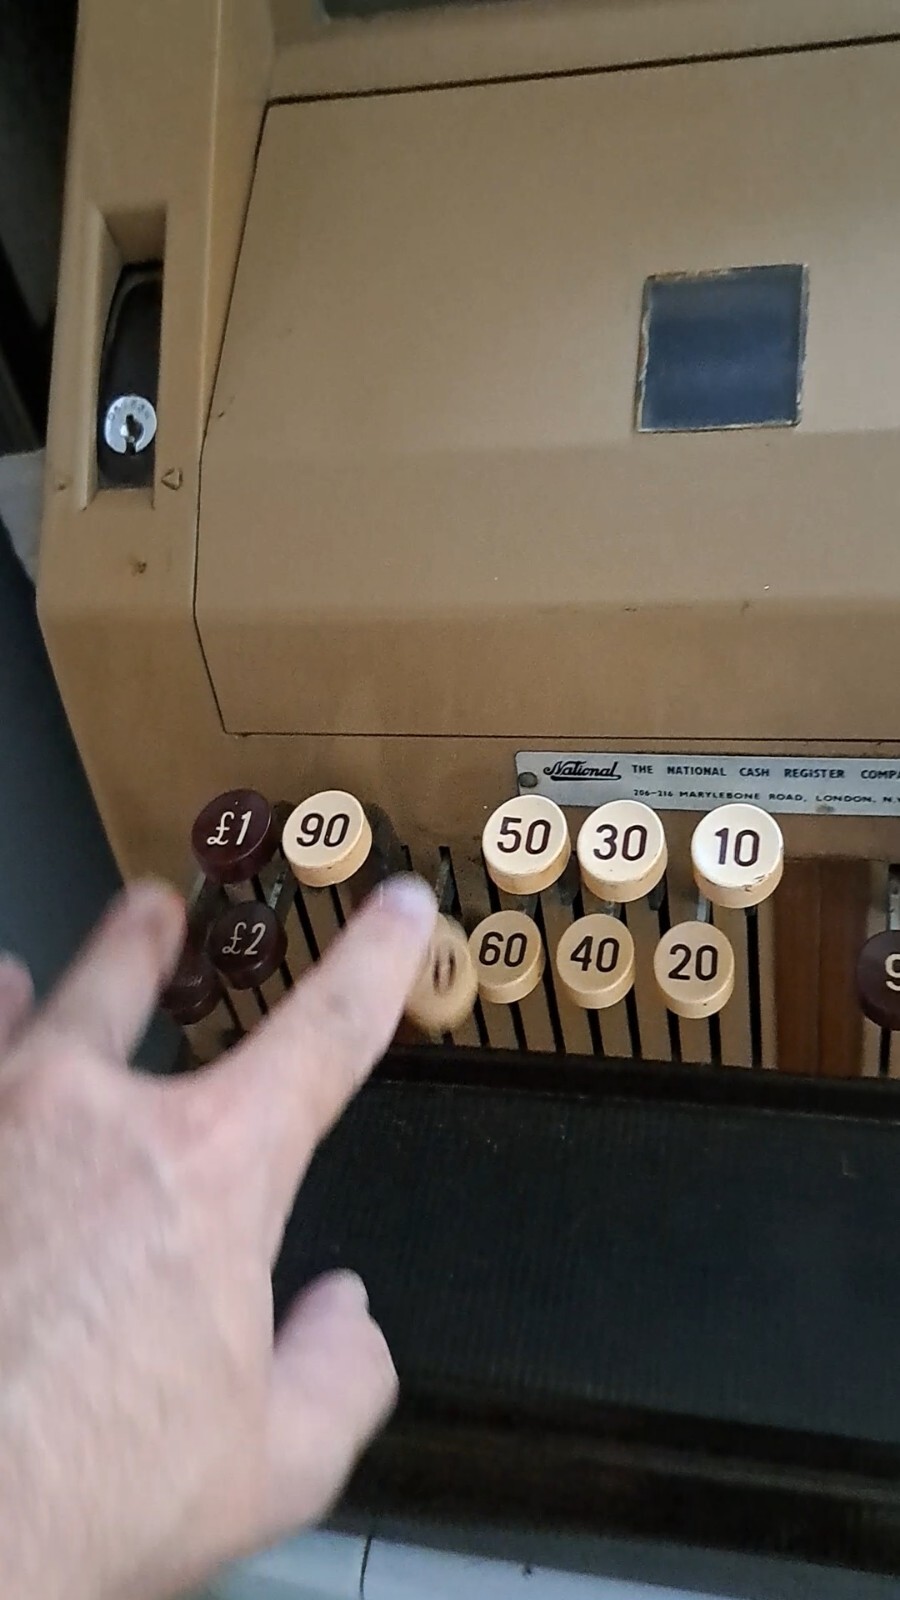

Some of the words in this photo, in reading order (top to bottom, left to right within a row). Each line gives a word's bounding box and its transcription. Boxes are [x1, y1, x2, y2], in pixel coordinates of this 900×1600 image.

[543, 760, 622, 781] National
[631, 764, 654, 774] THE
[667, 766, 727, 777] NATIONAL
[739, 767, 770, 777] CASH
[784, 768, 845, 779] REGISTER
[679, 791, 760, 800] MARYLEBONE
[768, 793, 807, 803] ROAD,
[206, 811, 252, 846] £1
[296, 812, 350, 847] 90
[497, 816, 551, 855] 50
[593, 823, 648, 862] 30
[714, 827, 760, 867] 10
[221, 921, 266, 956] £2
[478, 931, 528, 968] 60
[570, 935, 620, 974] 40
[668, 943, 718, 982] 20
